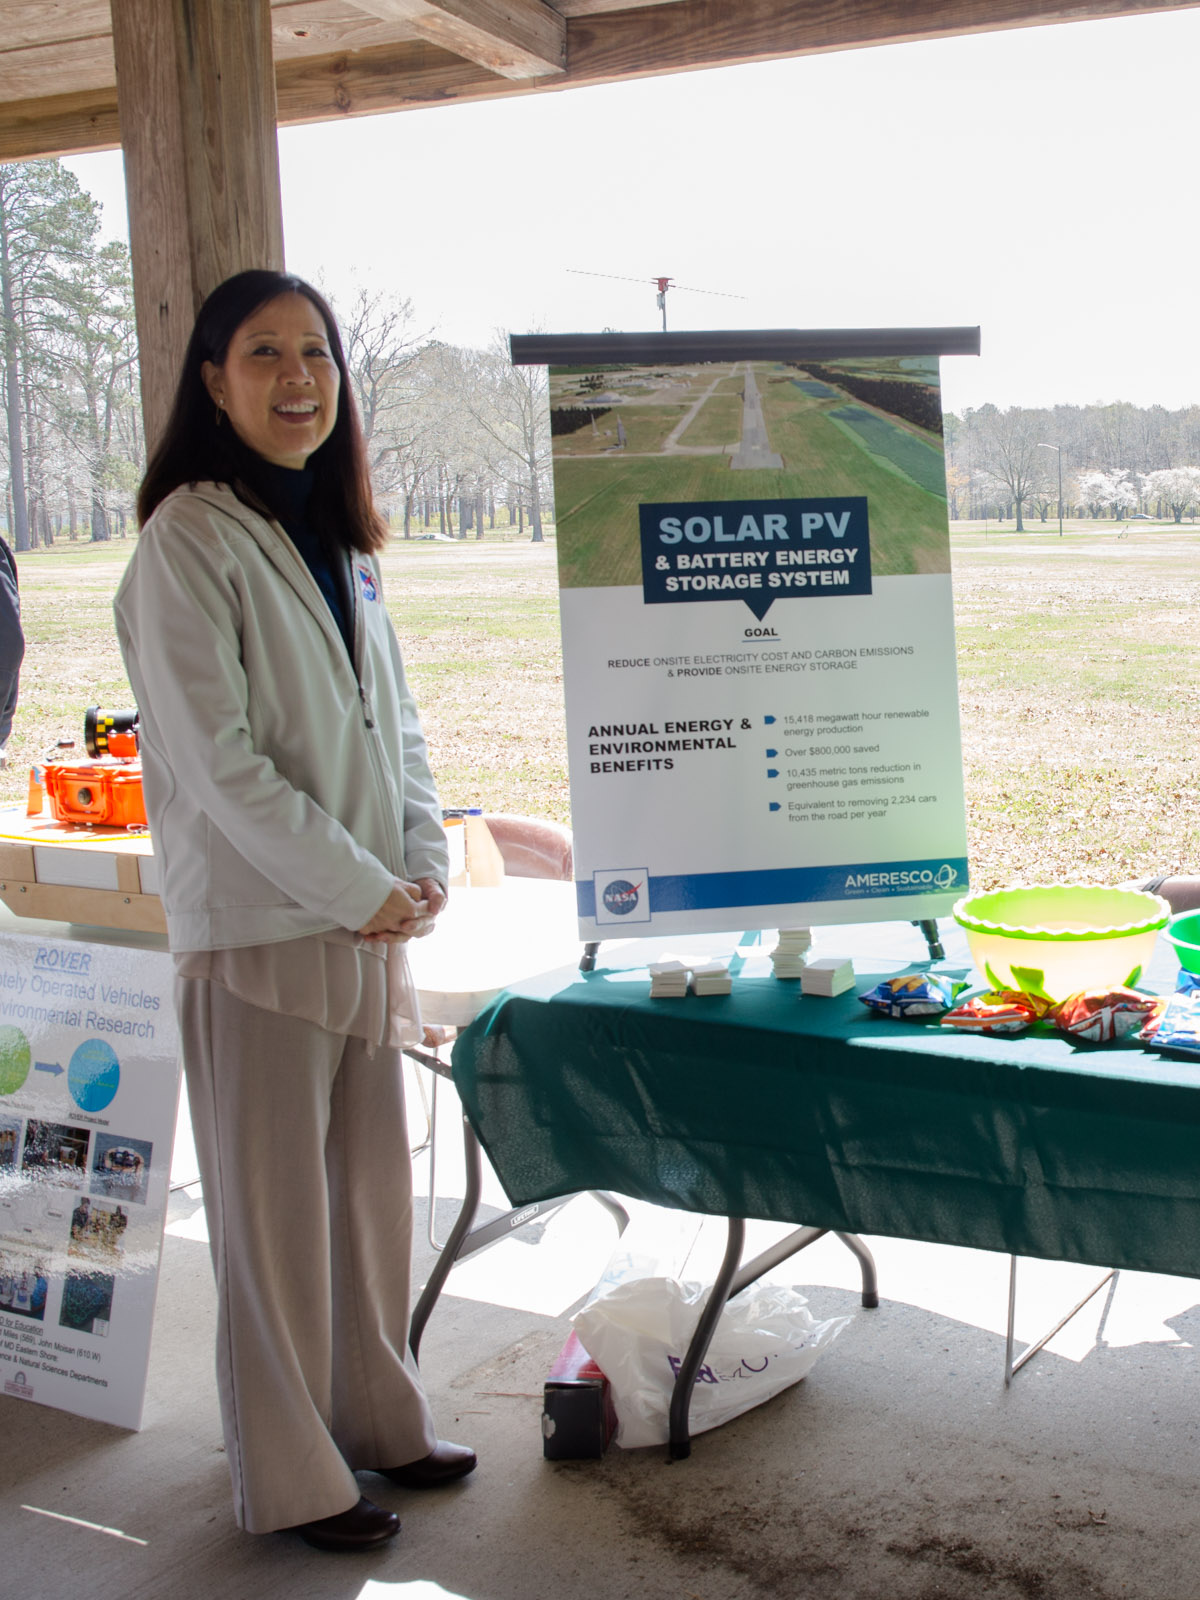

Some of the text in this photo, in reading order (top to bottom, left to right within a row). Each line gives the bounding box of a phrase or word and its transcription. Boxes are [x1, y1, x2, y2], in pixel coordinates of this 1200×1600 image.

[659, 512, 851, 544] SOLAR PV
[655, 548, 858, 570] & BATTERY ENERGY
[666, 570, 849, 592] STORAGE SYSTEM
[744, 628, 778, 638] GOAL
[608, 646, 914, 669] REDUCE ONSITE ELECTRICITY COST AND CARBON EMISSIONS
[667, 660, 857, 678] & PROVIDE ONSITE ENERGY STORAGE
[784, 709, 929, 725] 15,418 megawatt hour renewable
[588, 718, 752, 738] ANNUAL ENERGY &
[784, 725, 863, 738] energy production
[589, 737, 736, 755] ENVIRONMENTAL
[785, 744, 880, 757] Over $800,000 saved
[590, 758, 674, 774] BENEFITS
[787, 762, 921, 779] 10,435 metric tons reduction in
[787, 776, 905, 792] greenhouse gas emissions
[788, 795, 937, 812] Equivalent to removing 2,234 cars
[788, 810, 886, 822] from the road per year
[845, 870, 933, 888] AMERESCO
[605, 892, 637, 903] NASA
[35, 947, 92, 971] ROVER
[31, 974, 161, 1011] Operated Vehicles
[86, 1011, 155, 1039] Research
[15, 1320, 44, 1334] Education
[15, 1343, 38, 1356] Eastern
[19, 1356, 108, 1388] Natural Sciences Departments
